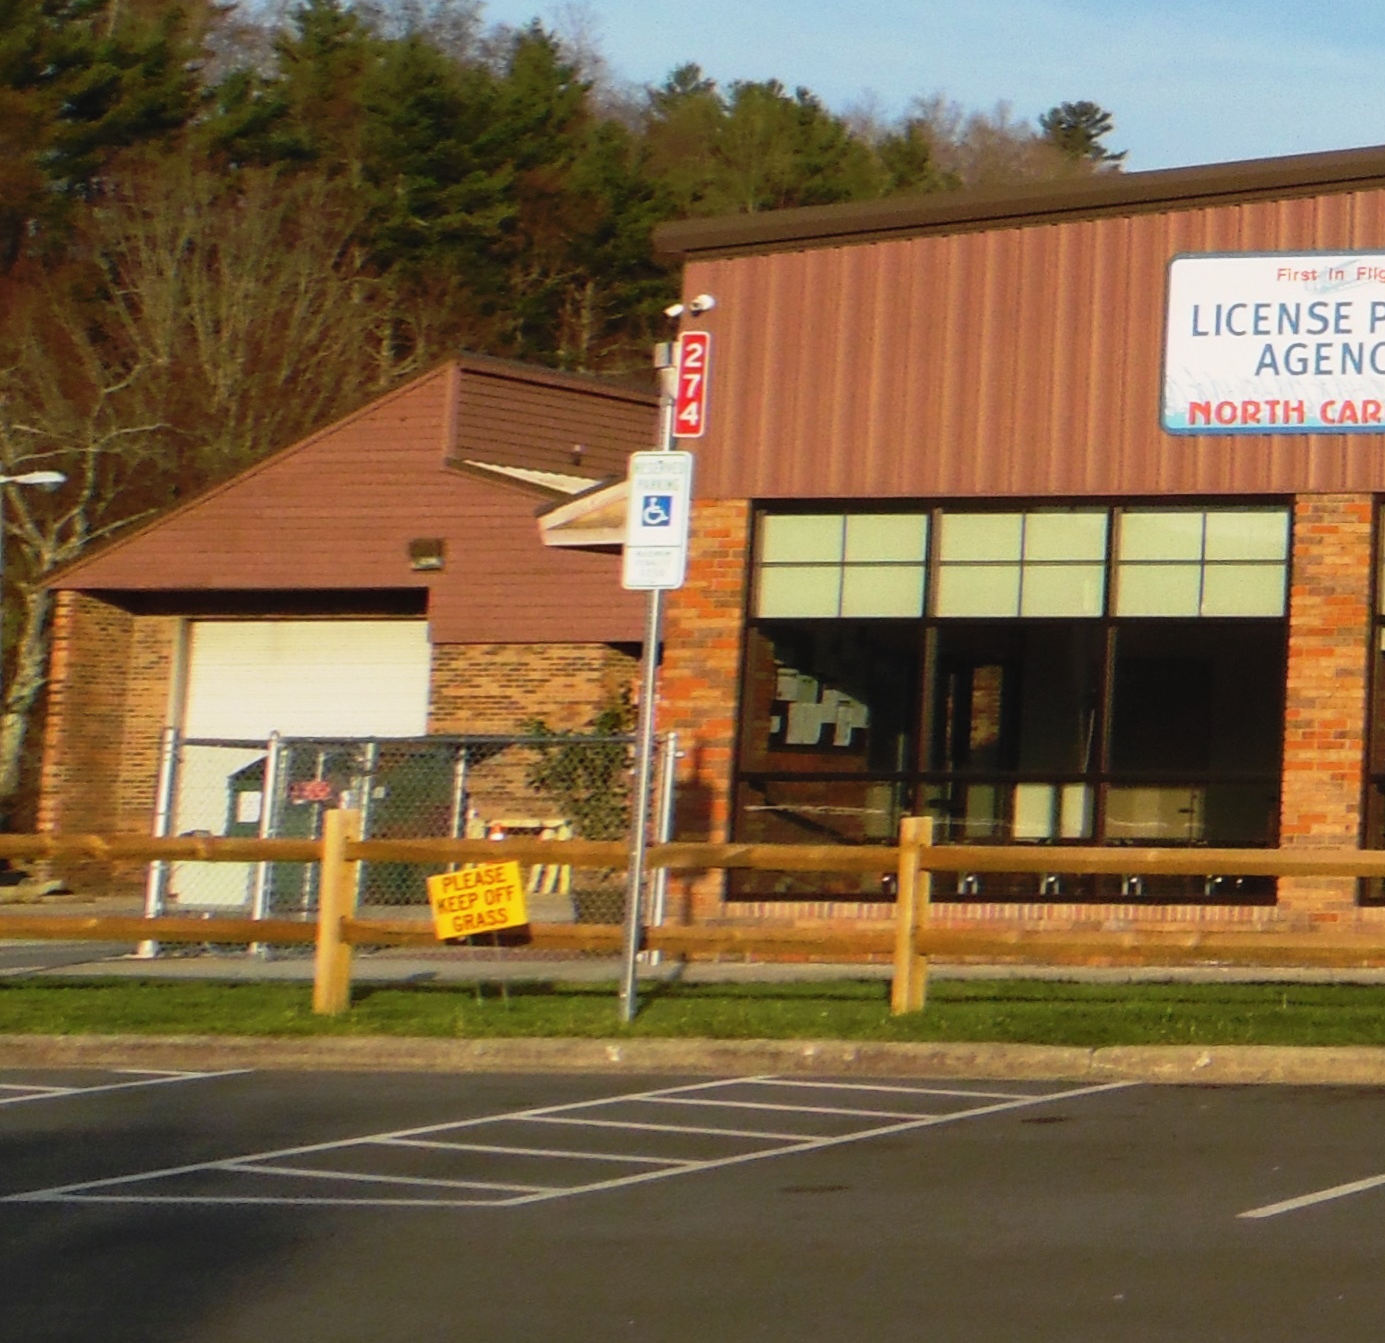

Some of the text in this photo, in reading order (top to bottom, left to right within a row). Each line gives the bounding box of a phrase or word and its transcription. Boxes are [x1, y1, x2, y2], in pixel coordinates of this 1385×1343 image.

[1277, 267, 1318, 281] First
[1328, 266, 1345, 281] In
[1192, 301, 1353, 337] LICENSE
[1187, 399, 1305, 426] NORTH
[441, 866, 506, 893] PLEASE
[437, 885, 515, 914] KEEP OFF
[453, 908, 508, 932] GRASS
